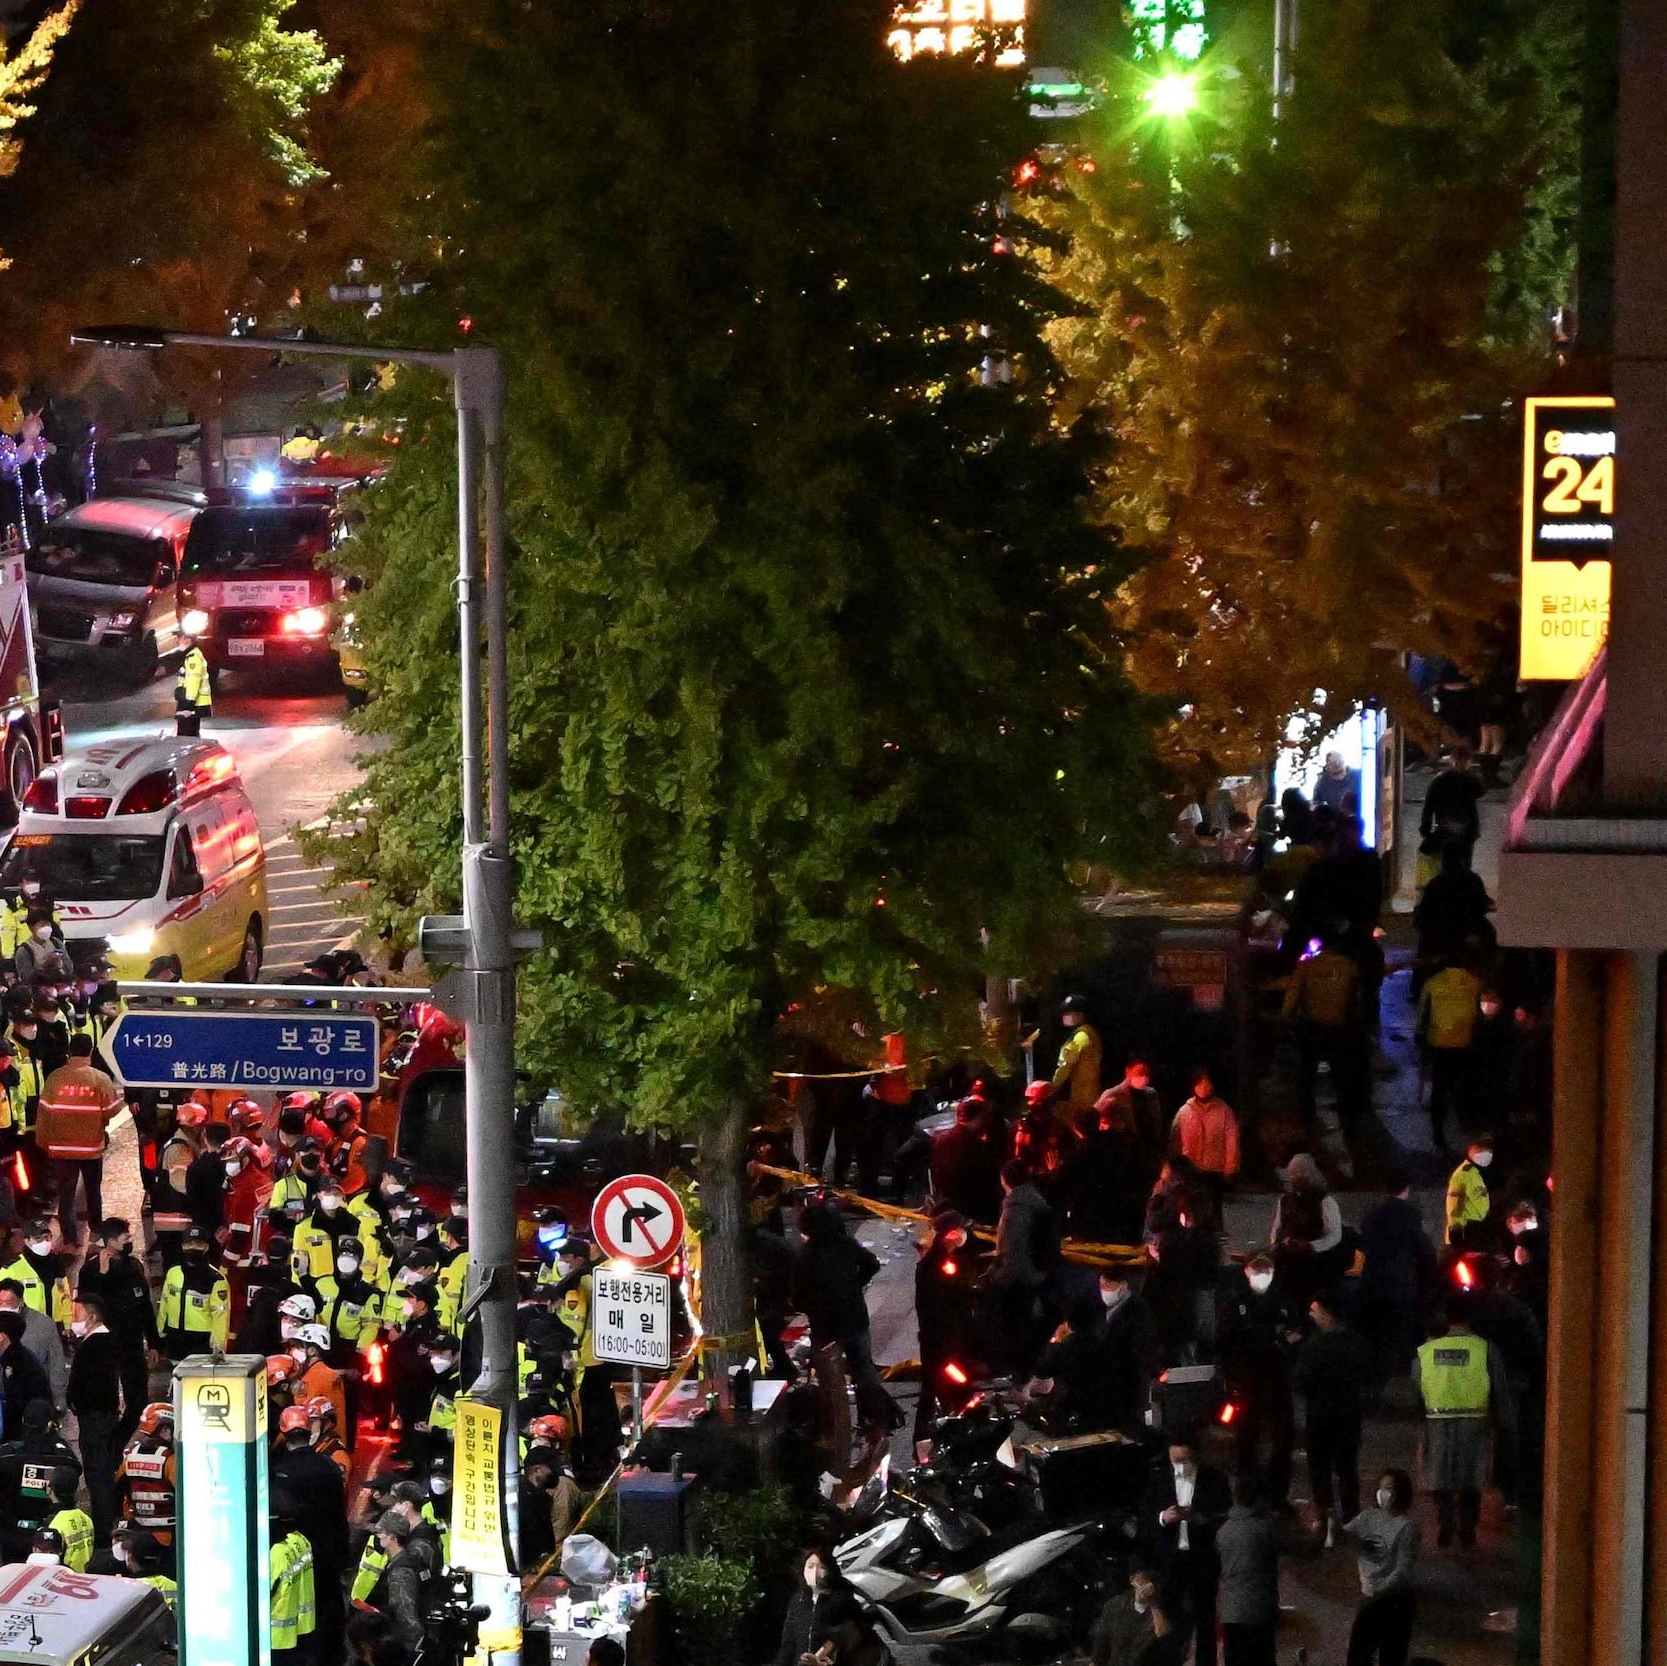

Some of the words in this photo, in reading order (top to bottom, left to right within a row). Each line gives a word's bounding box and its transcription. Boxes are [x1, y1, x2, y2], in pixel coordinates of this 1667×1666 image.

[1543, 457, 1613, 513] 24
[277, 1026, 366, 1056] 보광로
[172, 1061, 227, 1080] 普光路
[243, 1062, 367, 1084] Bogwang-ro
[598, 1279, 666, 1307] 보행전용거리
